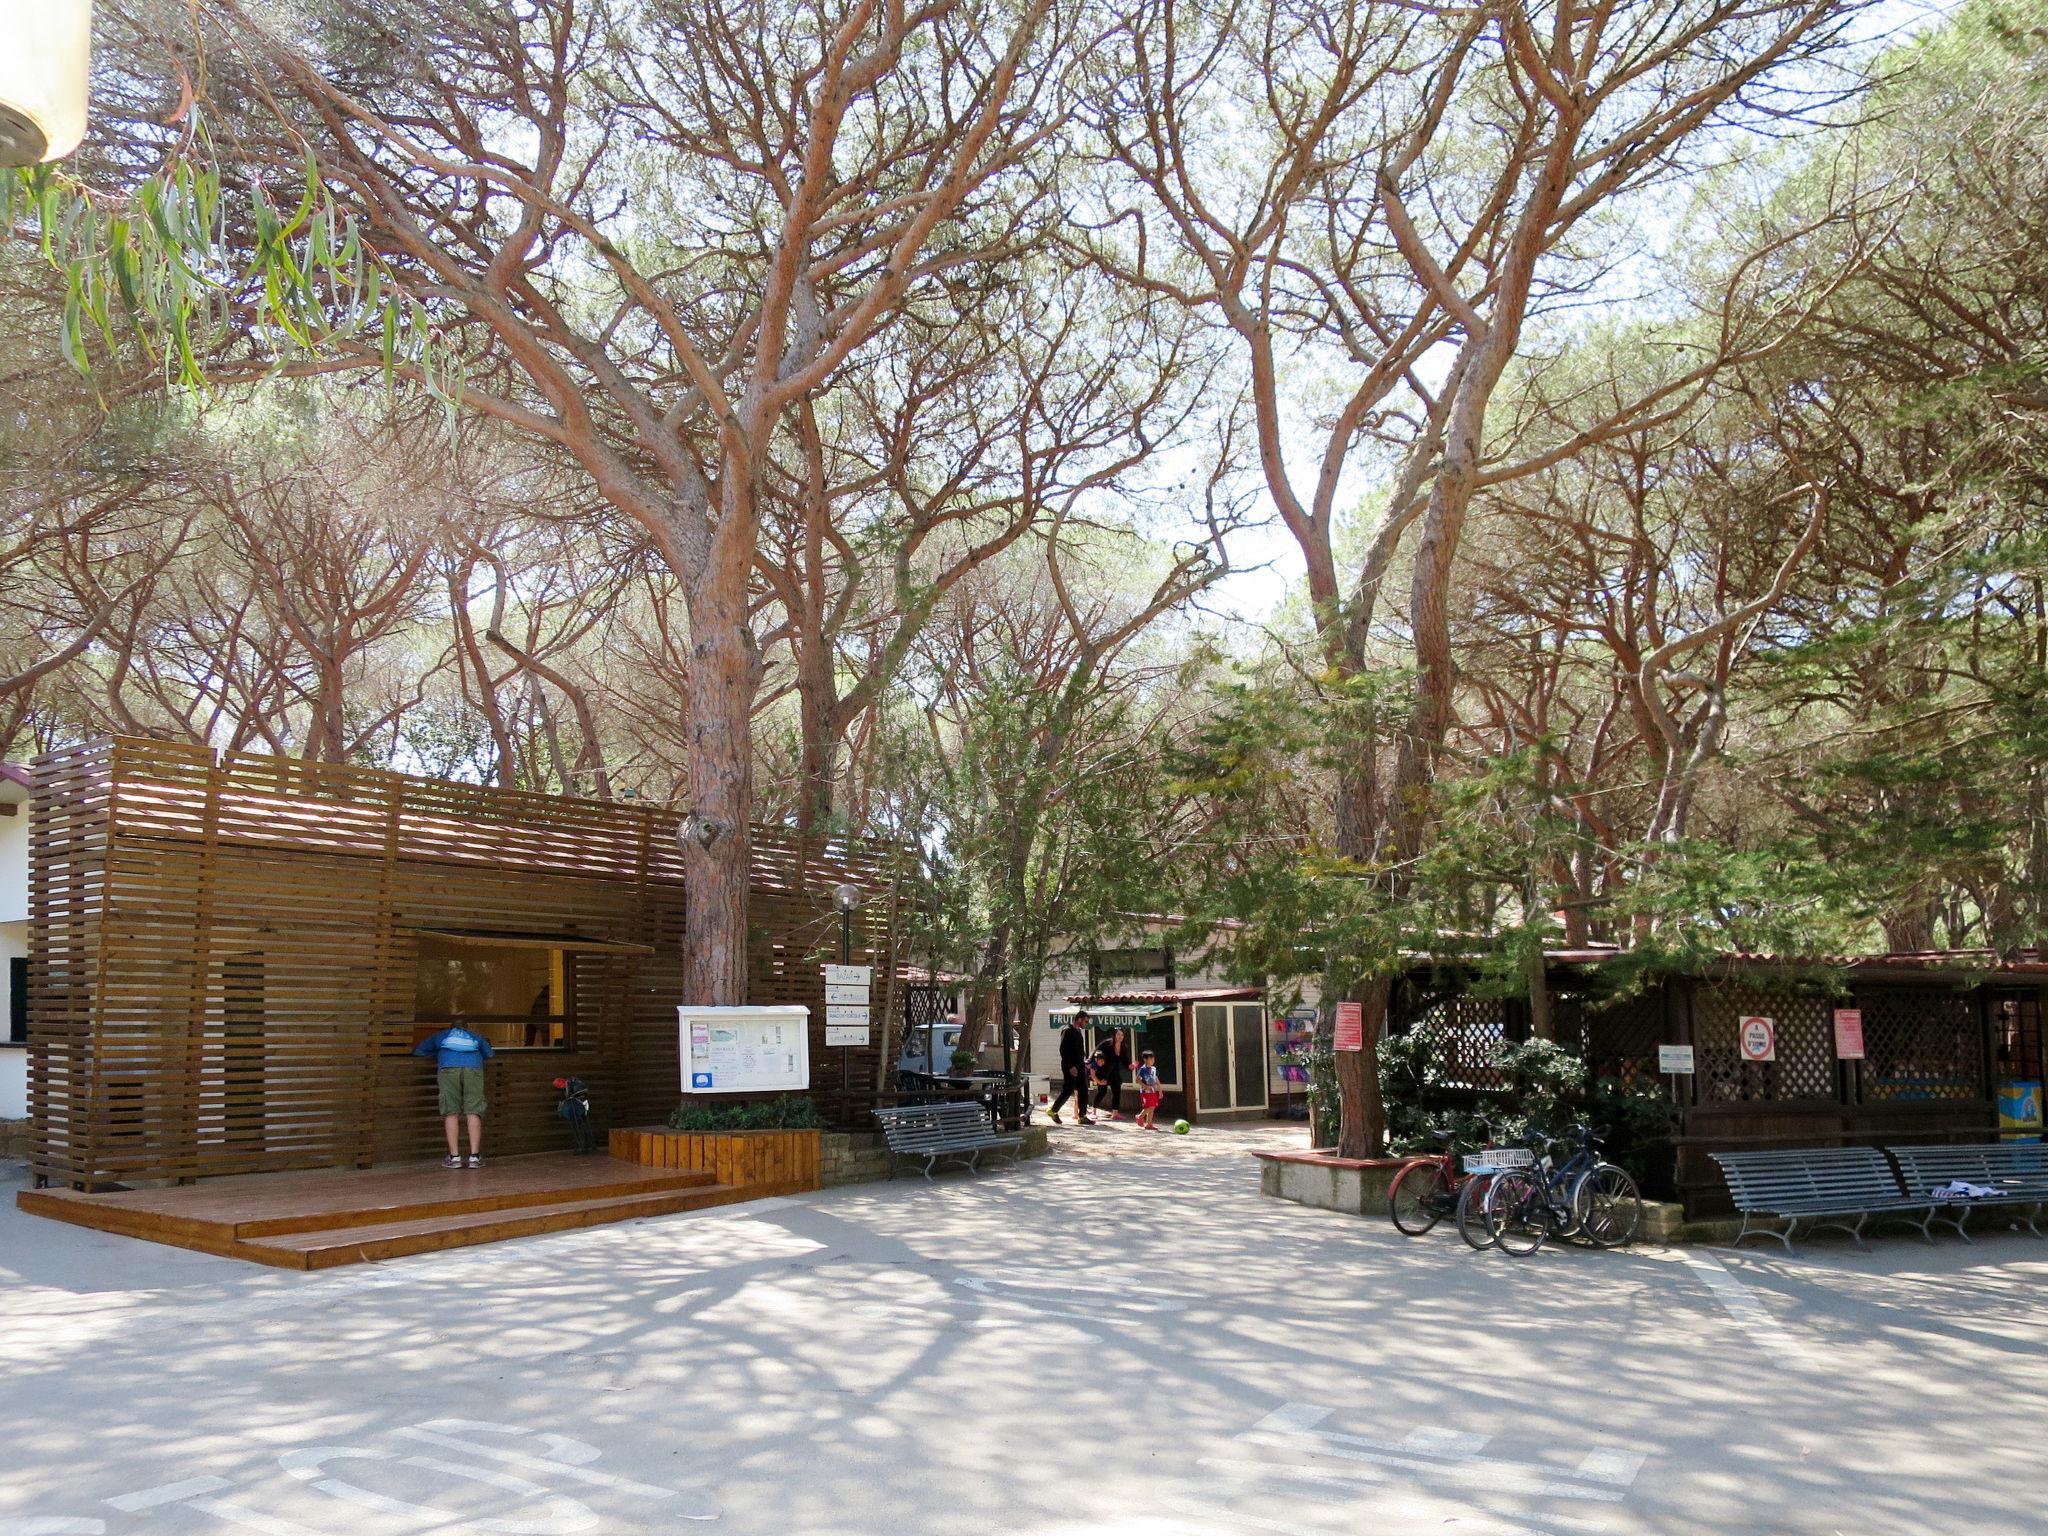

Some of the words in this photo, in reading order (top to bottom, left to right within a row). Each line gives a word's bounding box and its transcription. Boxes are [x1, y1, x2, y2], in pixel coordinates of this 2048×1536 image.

[1053, 1014, 1074, 1024] FRUT
[1097, 1015, 1142, 1026] VERDURA
[0, 1419, 678, 1536] TOP
